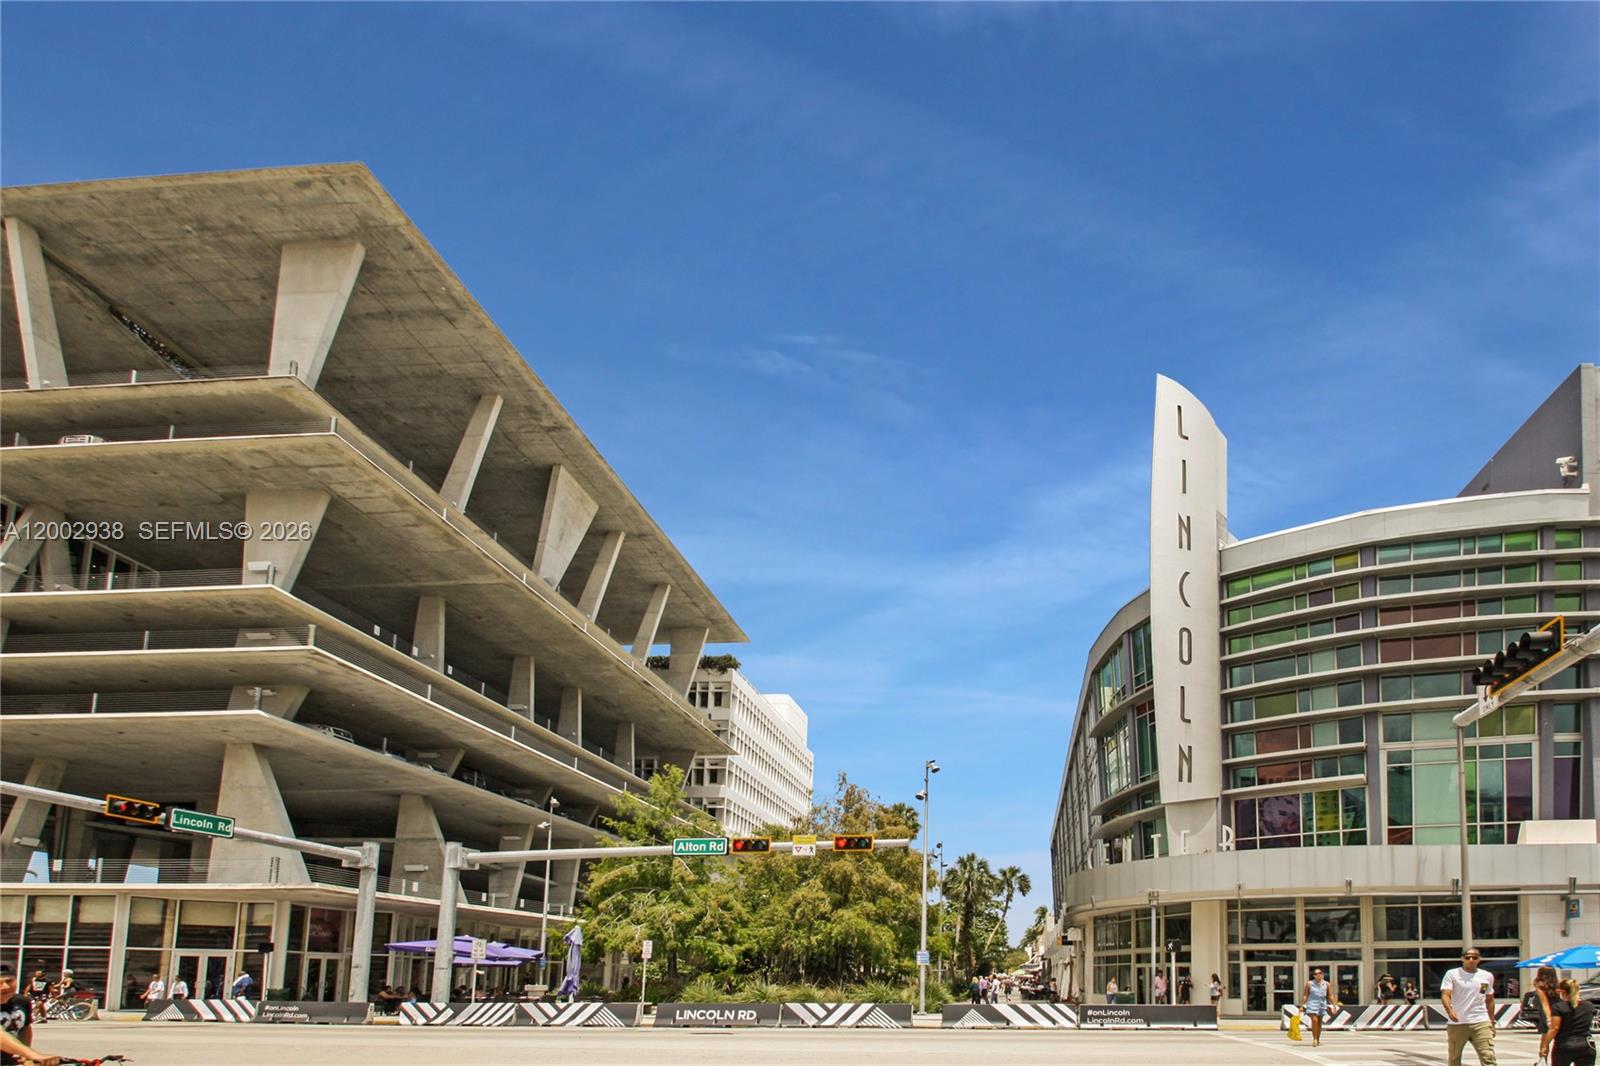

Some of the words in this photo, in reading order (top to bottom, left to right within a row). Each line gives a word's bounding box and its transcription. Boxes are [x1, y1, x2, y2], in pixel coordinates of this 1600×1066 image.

[1177, 404, 1193, 783] LINCOLN
[173, 813, 213, 829] Lincoln
[218, 821, 231, 833] Rd
[677, 841, 706, 852] Alton
[709, 841, 724, 852] Rd
[675, 1009, 735, 1020] LINCOLN
[737, 1010, 757, 1020] RD
[1087, 1016, 1144, 1024] LincolnRd.com
